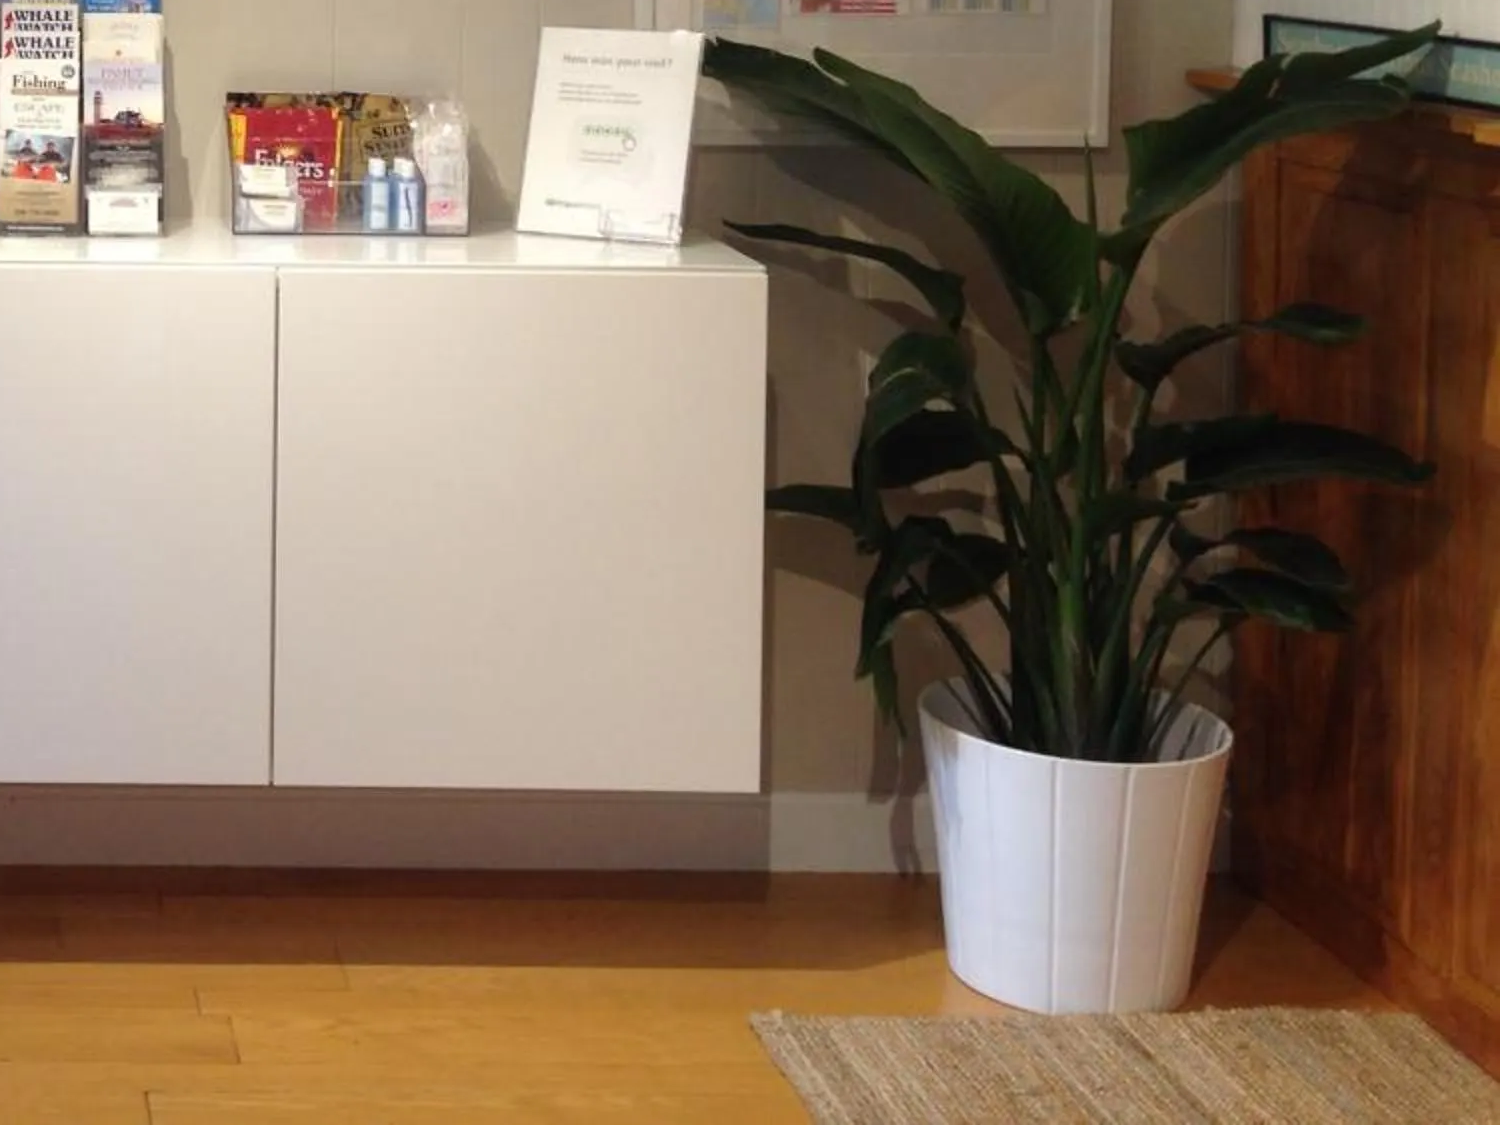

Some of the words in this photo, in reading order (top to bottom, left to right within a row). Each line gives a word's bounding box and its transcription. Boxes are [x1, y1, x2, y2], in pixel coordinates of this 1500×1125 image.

[13, 9, 74, 22] WHALE
[14, 36, 76, 49] WHALE
[11, 74, 68, 90] Fishing
